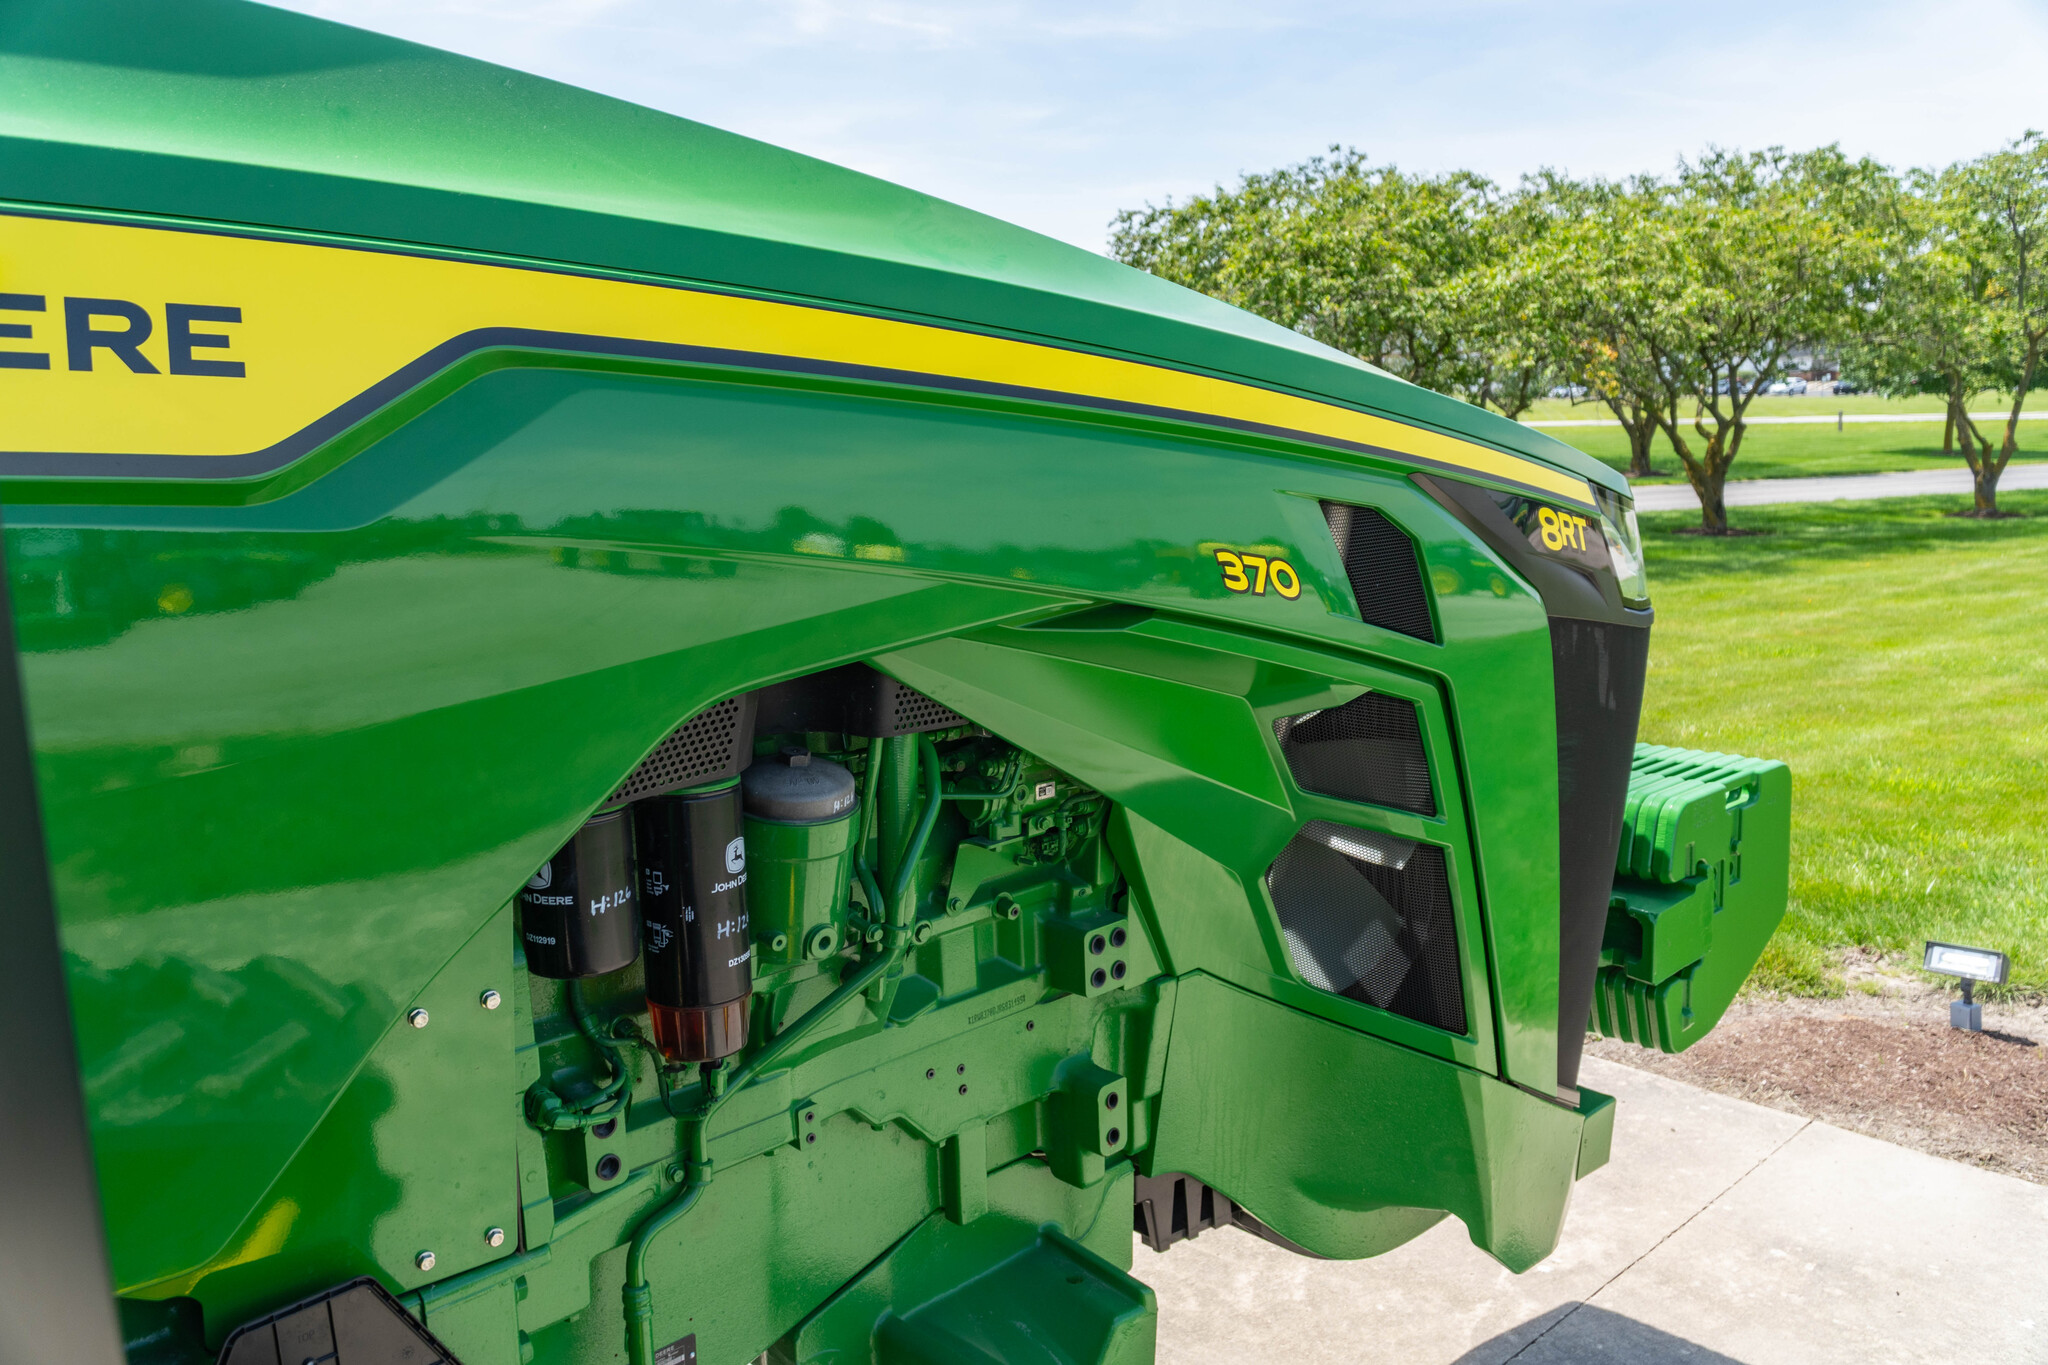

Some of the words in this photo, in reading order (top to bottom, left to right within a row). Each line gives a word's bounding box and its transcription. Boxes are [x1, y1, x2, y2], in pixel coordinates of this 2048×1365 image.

[1538, 507, 1587, 552] 8RT
[1213, 549, 1301, 601] 370
[532, 894, 574, 905] DEERE
[591, 886, 631, 916] H:126
[711, 879, 737, 894] JOHN
